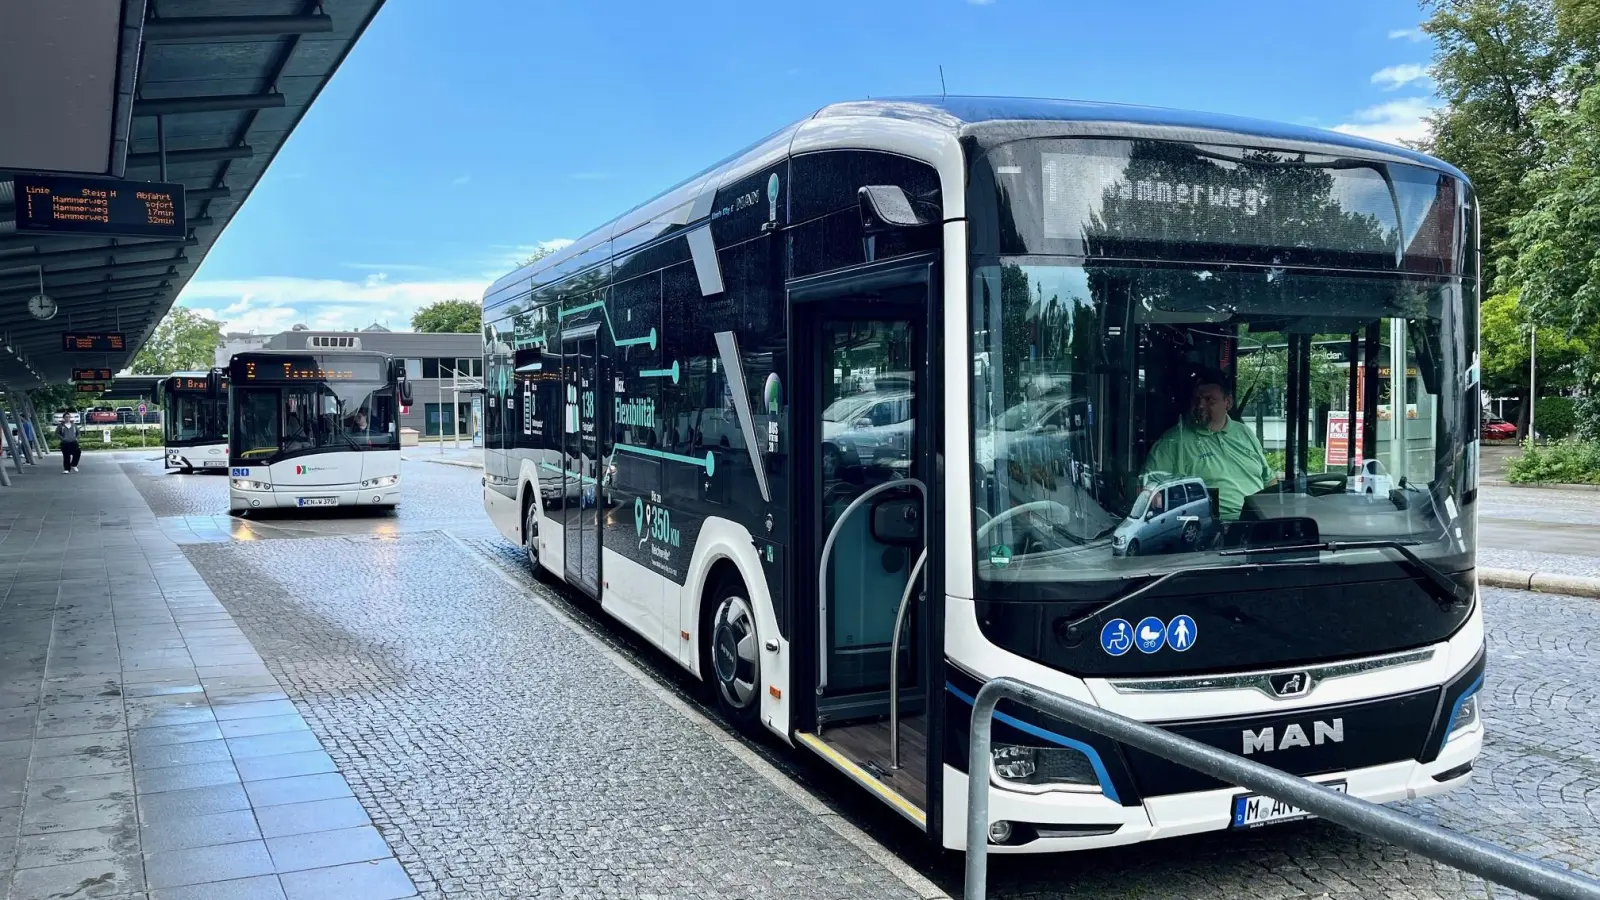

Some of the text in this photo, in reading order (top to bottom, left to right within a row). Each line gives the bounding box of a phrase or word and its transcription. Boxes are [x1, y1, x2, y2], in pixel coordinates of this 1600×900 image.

[1043, 160, 1057, 202] 1
[26, 186, 171, 200] Linie Steig H Abfahrt
[52, 196, 108, 206] Hammerweg
[145, 201, 174, 209] sofort
[53, 204, 108, 214] Hammerweg
[148, 208, 174, 217] 17min
[54, 212, 108, 222] Hammerweg
[148, 216, 174, 224] 32min
[176, 379, 182, 388] 3
[582, 390, 594, 418] 138
[615, 396, 656, 428] Flexibilität
[652, 506, 680, 548] 350 KM
[1242, 718, 1344, 755] MAN
[1247, 799, 1260, 820] M
